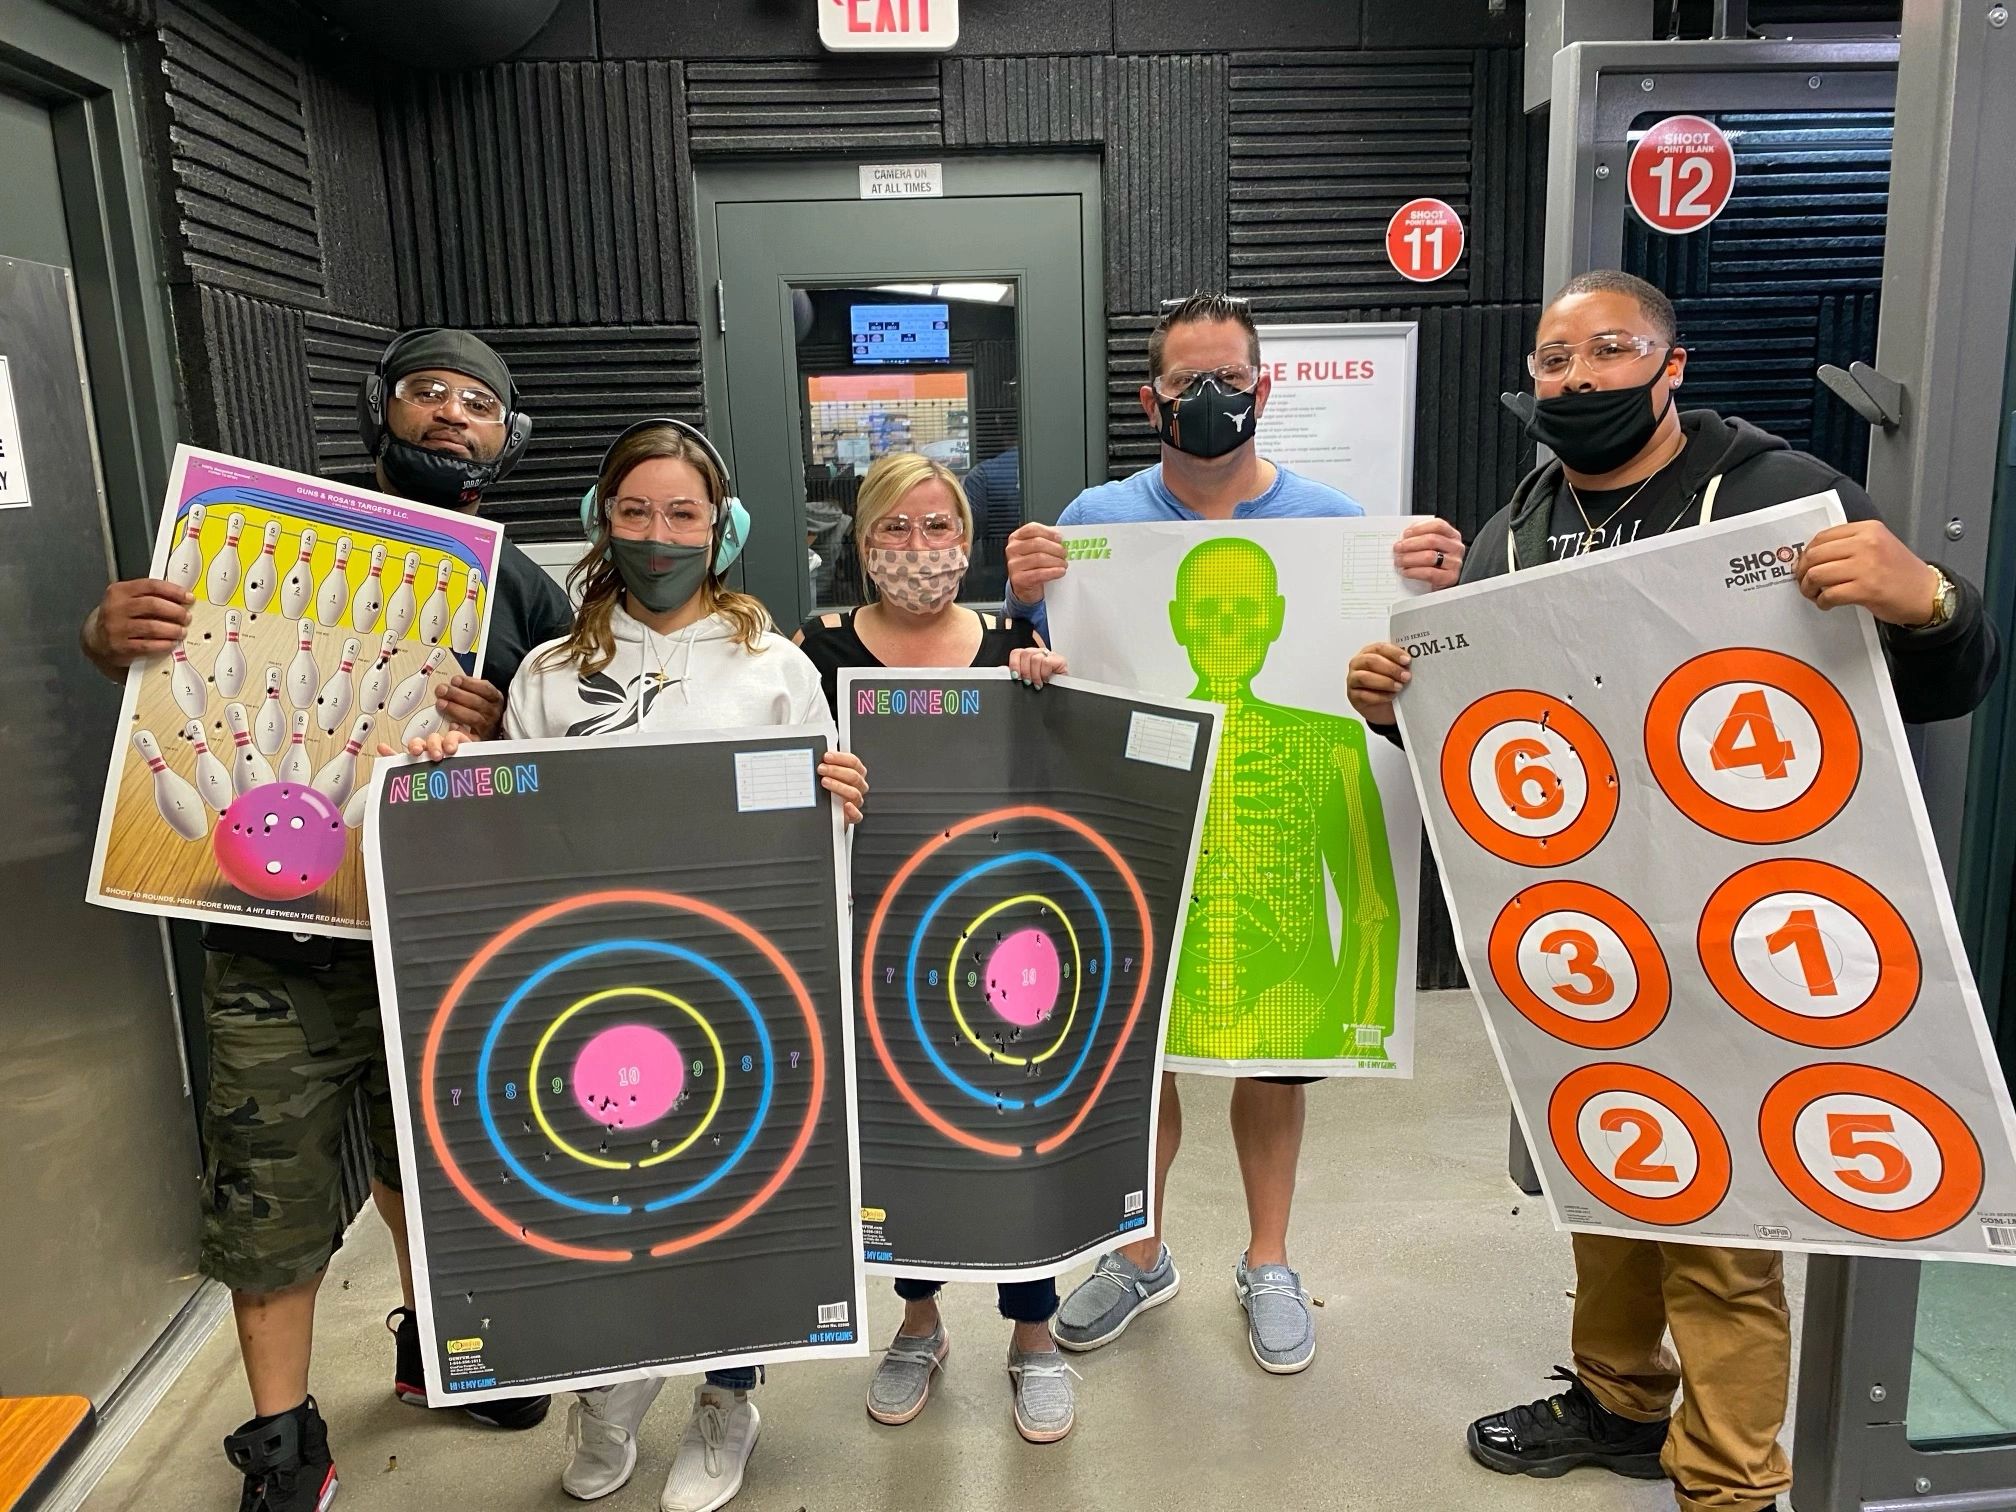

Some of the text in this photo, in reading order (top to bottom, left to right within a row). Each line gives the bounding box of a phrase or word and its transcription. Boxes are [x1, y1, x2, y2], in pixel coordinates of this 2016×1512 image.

[1664, 133, 1710, 145] SHOOT
[1657, 145, 1714, 154] POINT BLANK
[874, 168, 927, 179] CAMERA ON
[871, 182, 932, 194] AT ALL TIMES
[1650, 157, 1713, 216] 12
[1410, 210, 1444, 219] SHOOT
[1403, 227, 1443, 270] 11
[1297, 361, 1374, 381] RULES
[296, 487, 318, 498] GUNS
[328, 494, 356, 506] ROSA'S
[357, 501, 391, 515] TARGETS
[393, 510, 408, 519] LLC.
[1062, 538, 1107, 549] RADIO
[1066, 549, 1112, 560] CTIVE
[1729, 542, 1805, 574] SHOOT
[1725, 570, 1766, 588] POINT
[1400, 634, 1469, 658] OM-1A
[857, 690, 979, 715] NEONEON
[1709, 689, 1796, 780] 4
[389, 765, 539, 804] NEONEON
[1494, 738, 1565, 820] 6
[105, 886, 131, 897] SHOOT
[177, 897, 195, 905] HIGH
[197, 900, 221, 909] SCORE
[223, 903, 243, 911] WINS.
[265, 909, 300, 919] BETWEEN
[331, 916, 355, 925] BANDS
[1765, 909, 1839, 997] 1
[1063, 962, 1070, 978] 9
[1089, 959, 1098, 974] 8
[1124, 958, 1133, 972] 7
[1539, 928, 1615, 1006] 3
[886, 968, 895, 983] 7
[928, 970, 938, 985] 8
[967, 971, 977, 987] 9
[1021, 968, 1036, 987] 10
[741, 1055, 753, 1072] 8
[790, 1051, 800, 1068] 7
[619, 1066, 640, 1087] 10
[692, 1060, 703, 1077] 9
[505, 1083, 517, 1099] 8
[552, 1077, 563, 1094] 9
[451, 1088, 462, 1106] 7
[1599, 1108, 1680, 1183] 2
[1826, 1114, 1913, 1195] 5
[867, 1251, 892, 1261] MY GUNS
[825, 1332, 835, 1342] MY
[835, 1331, 853, 1341] GUNS
[465, 1379, 477, 1389] MY
[477, 1378, 496, 1388] GUNS
